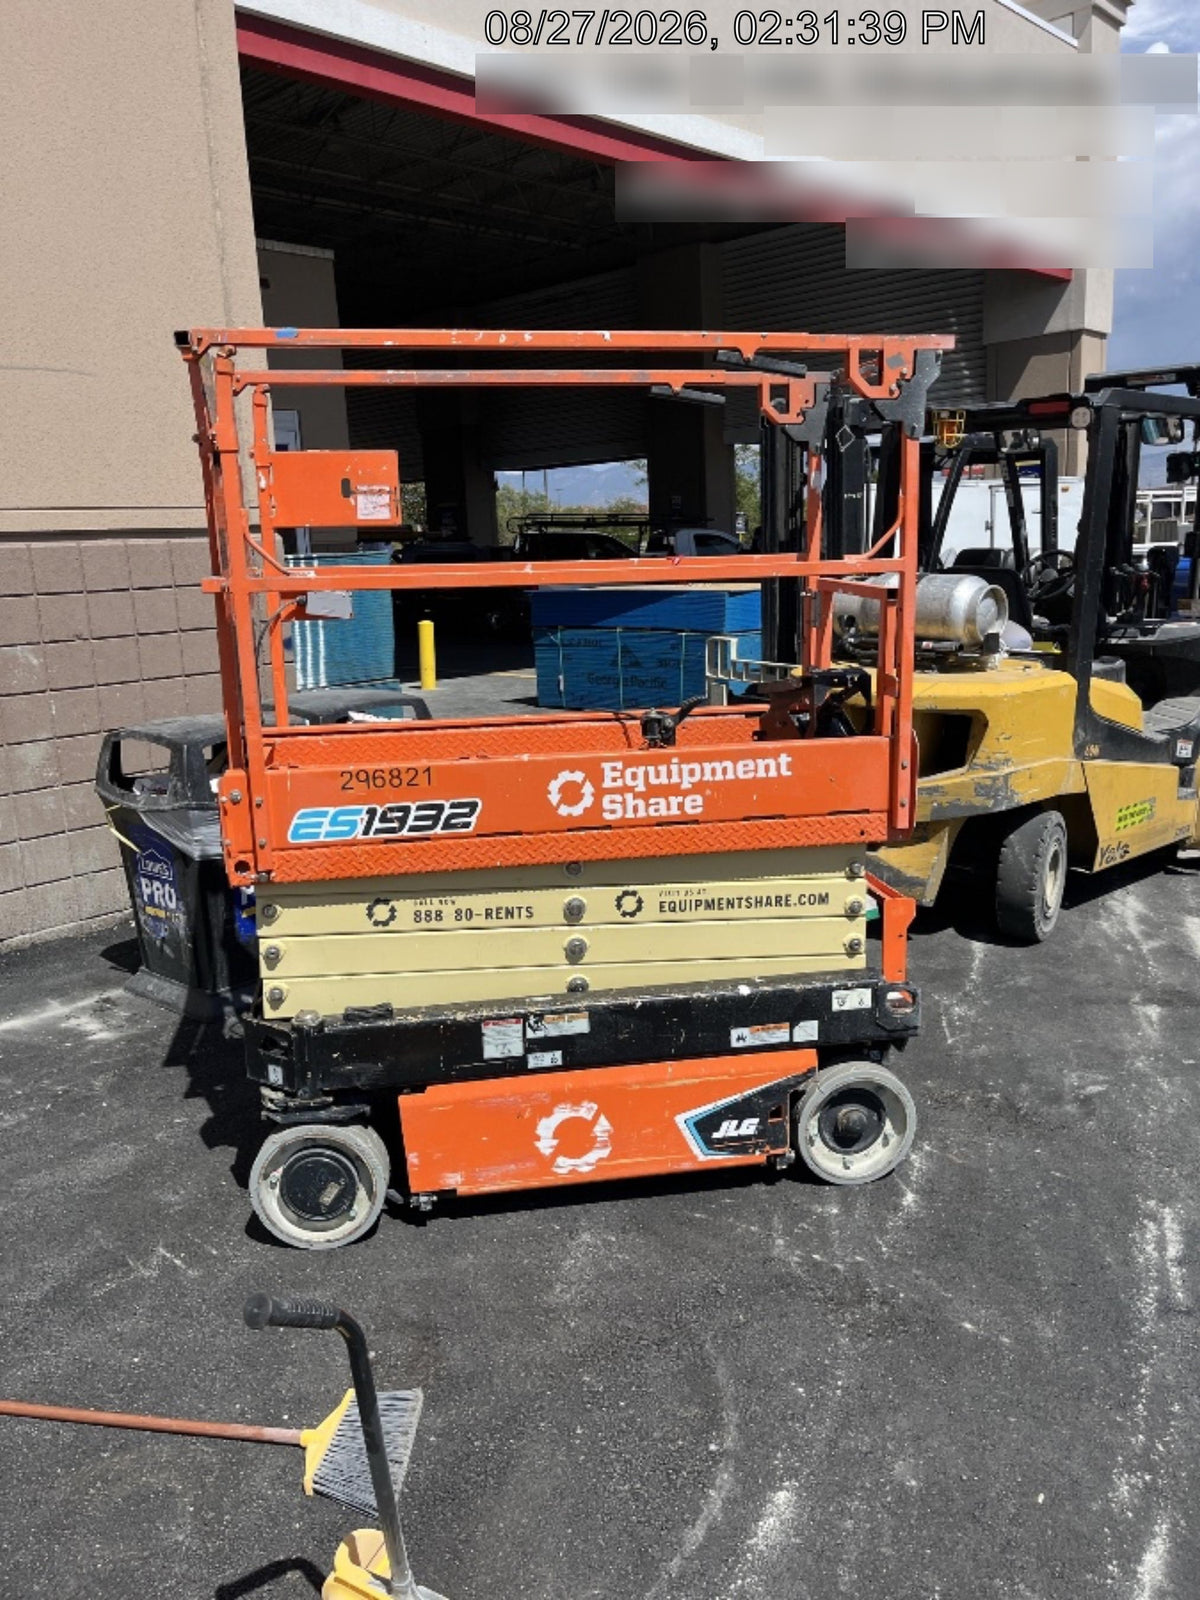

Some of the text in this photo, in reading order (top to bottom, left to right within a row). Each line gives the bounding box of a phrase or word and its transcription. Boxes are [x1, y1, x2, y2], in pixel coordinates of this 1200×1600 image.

[340, 766, 432, 791] 296821
[601, 753, 792, 792] Equipment
[602, 791, 704, 820] Share
[289, 799, 481, 842] ES1932
[140, 876, 177, 910] PRO
[659, 892, 830, 914] EQUIPMENTSHARE.COM
[413, 905, 534, 924] 888 80-RENTS
[711, 1117, 760, 1139] JLG
